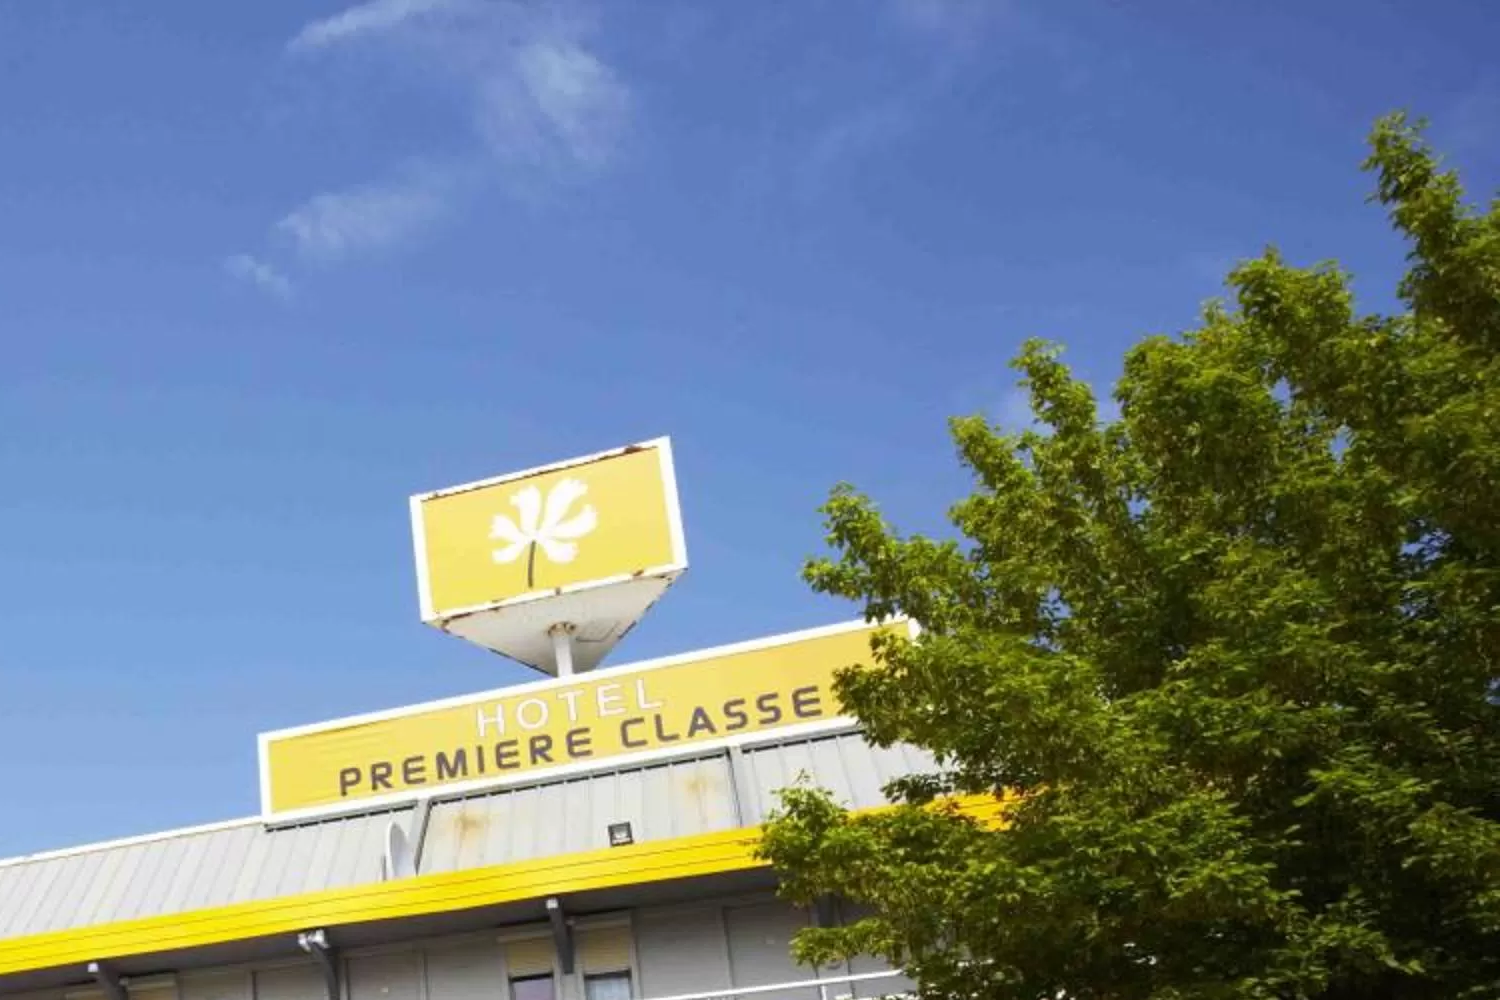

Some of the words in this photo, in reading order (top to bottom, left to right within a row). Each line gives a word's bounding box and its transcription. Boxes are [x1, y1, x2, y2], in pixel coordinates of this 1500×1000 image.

[340, 728, 592, 797] PREMIERE
[621, 686, 823, 748] CLASSE
[476, 677, 664, 738] HOTEL
